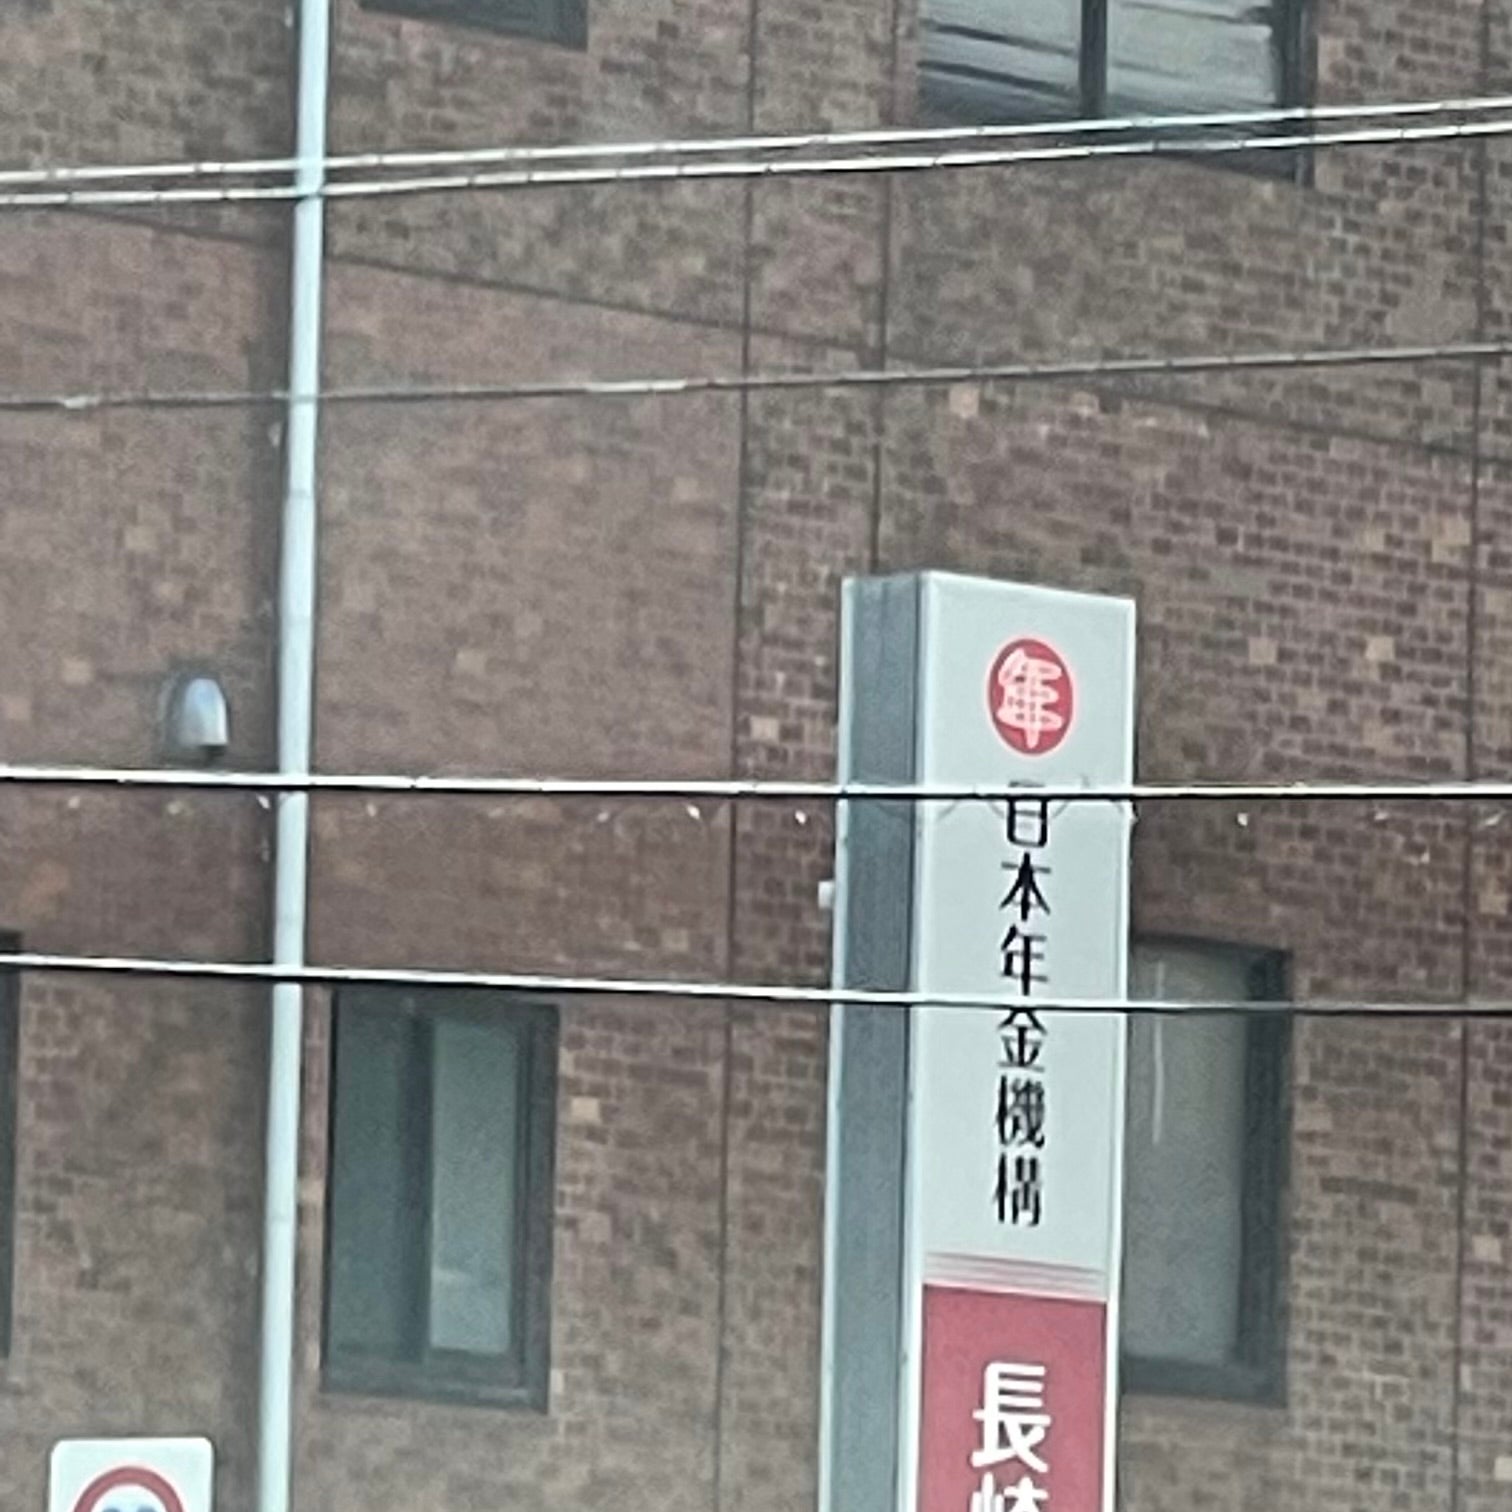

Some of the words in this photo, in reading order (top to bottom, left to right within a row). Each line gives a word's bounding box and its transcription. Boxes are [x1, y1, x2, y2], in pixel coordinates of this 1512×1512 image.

[993, 780, 1053, 1228] 日本年金機構
